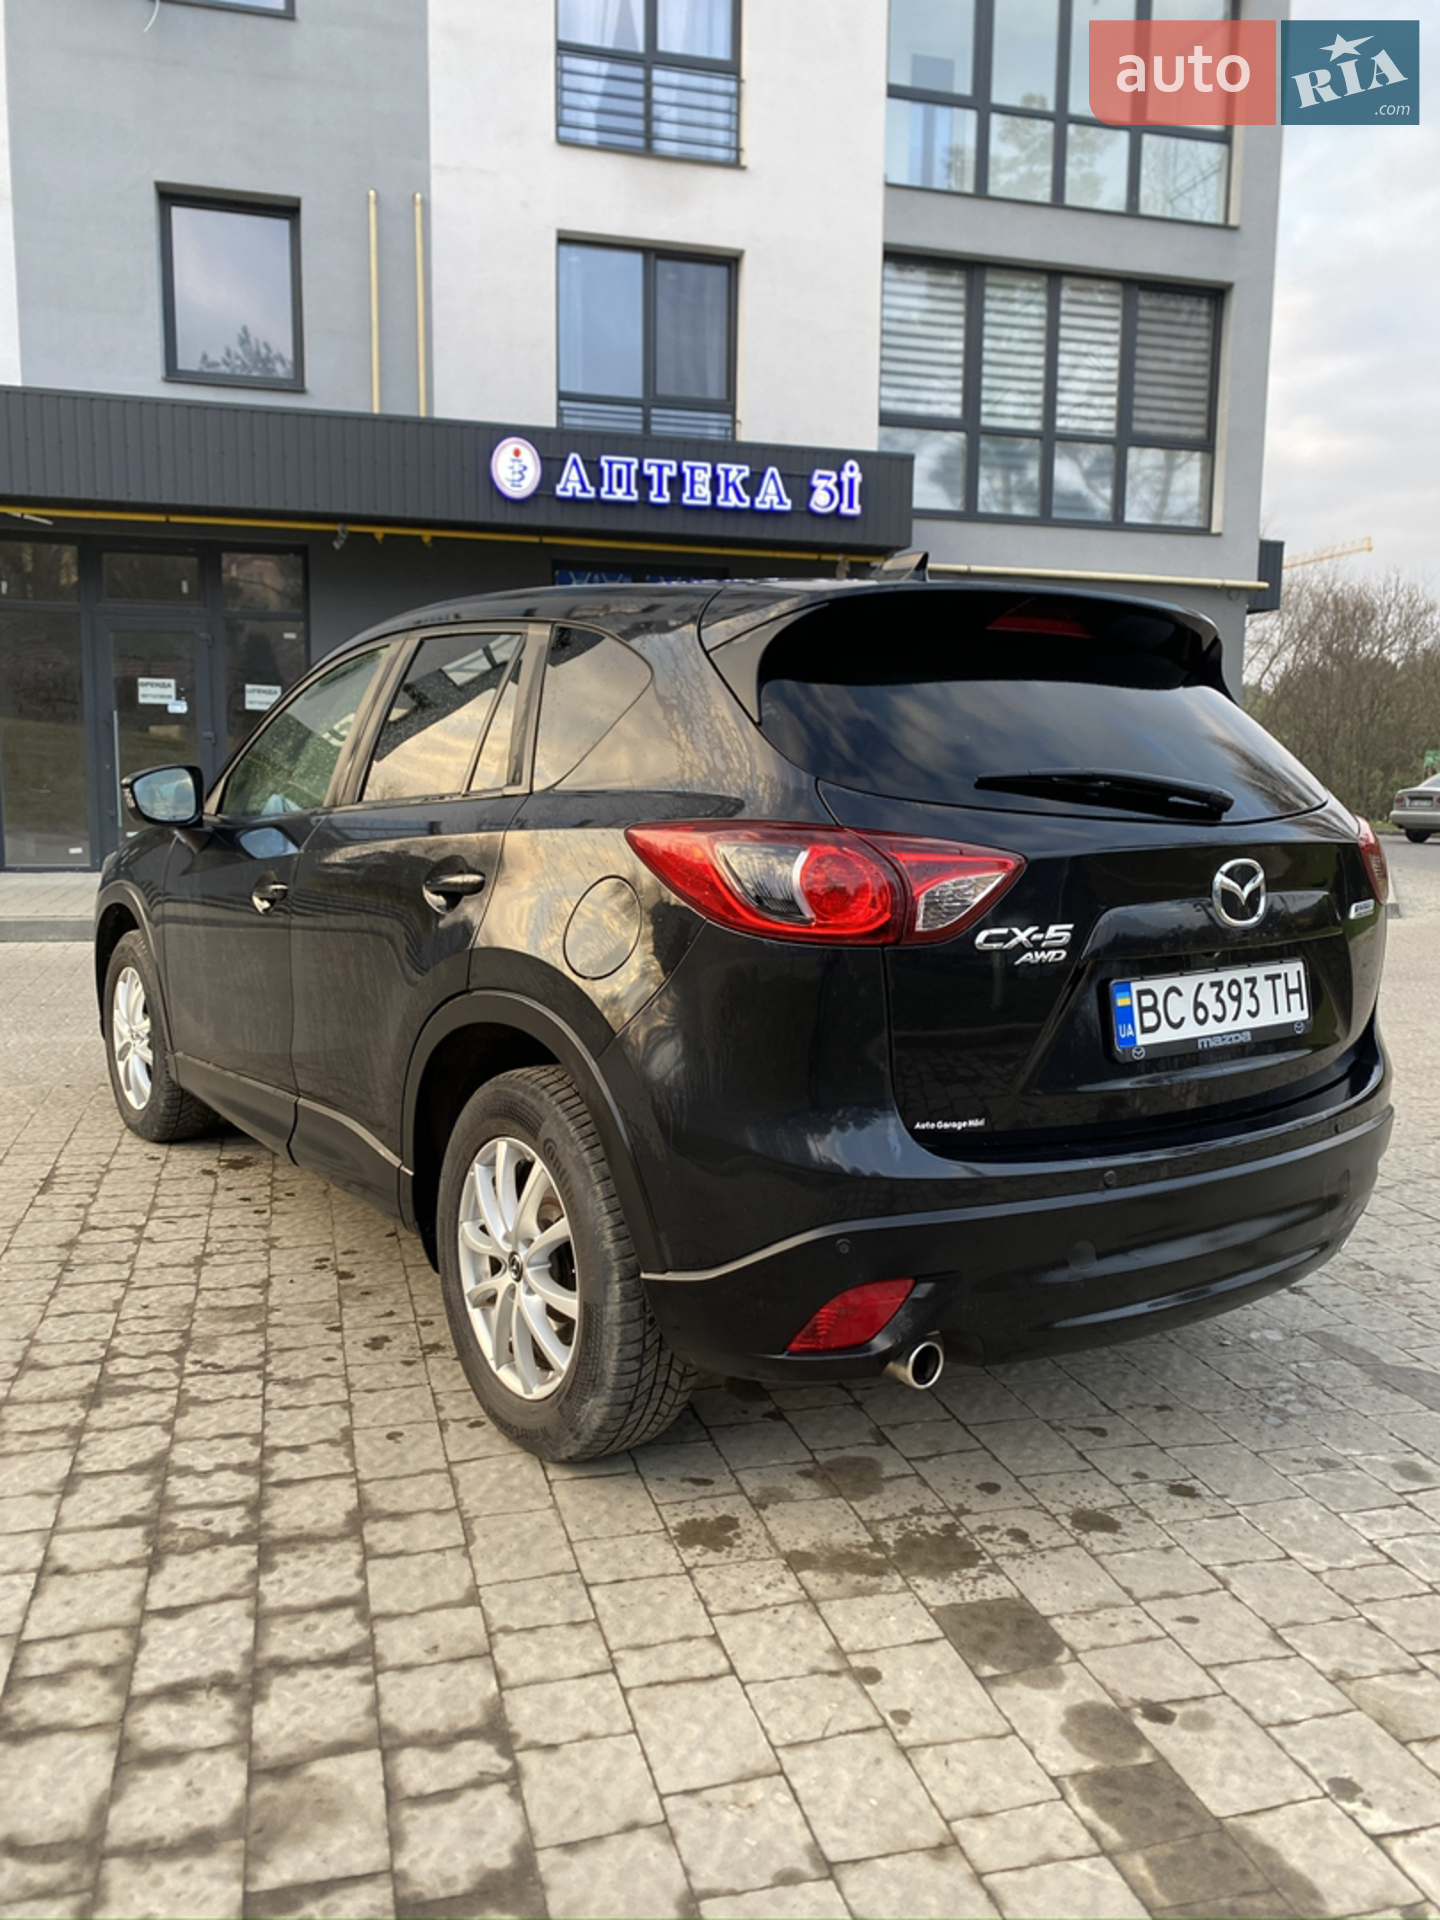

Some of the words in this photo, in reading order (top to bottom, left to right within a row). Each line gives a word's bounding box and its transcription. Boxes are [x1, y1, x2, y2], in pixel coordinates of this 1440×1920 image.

[556, 453, 792, 511] АПТЕКА
[975, 923, 1074, 952] CX-5
[1014, 949, 1067, 966] AWD
[1137, 985, 1186, 1036] BC
[1192, 976, 1260, 1027] 6393
[1264, 970, 1305, 1016] TH
[1119, 1023, 1135, 1038] UA
[1197, 1030, 1252, 1050] mazda
[914, 1121, 935, 1130] Auto
[937, 1119, 967, 1131] Garage
